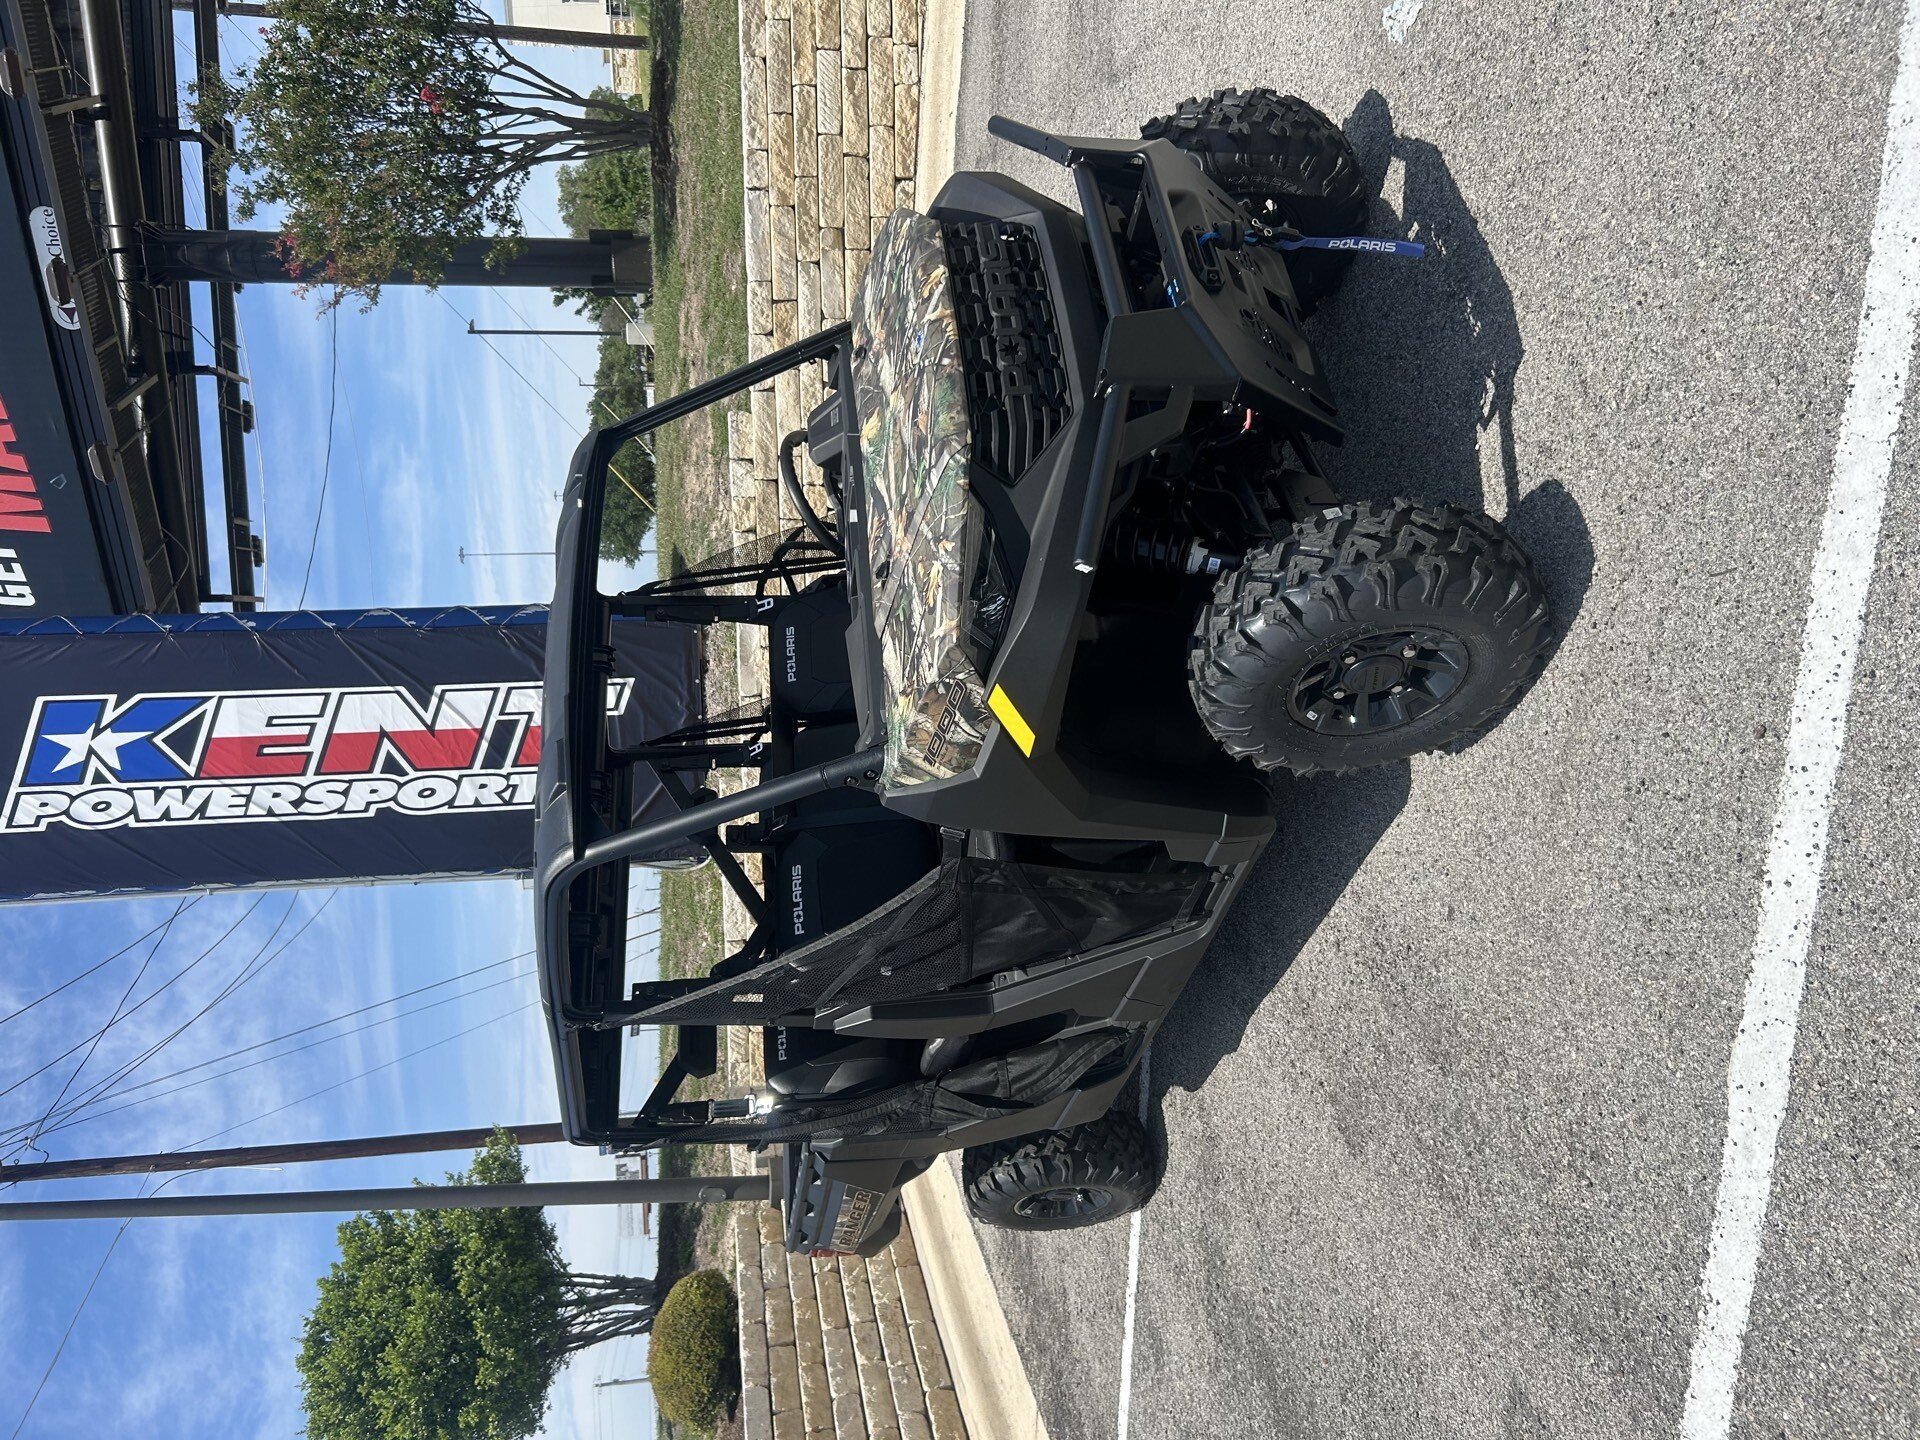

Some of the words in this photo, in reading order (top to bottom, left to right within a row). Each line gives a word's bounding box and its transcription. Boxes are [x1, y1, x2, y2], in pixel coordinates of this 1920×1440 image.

[42, 209, 62, 257] Choice
[1328, 239, 1397, 252] POLARIS
[978, 239, 1033, 396] POLARIS
[786, 626, 797, 682] POLARIS
[22, 680, 634, 789] KENT
[922, 678, 967, 767] 1000
[9, 772, 537, 829] POWERSPORT
[792, 864, 804, 935] POLARIS
[777, 1026, 788, 1060] POLA
[838, 1189, 872, 1246] RANGER
